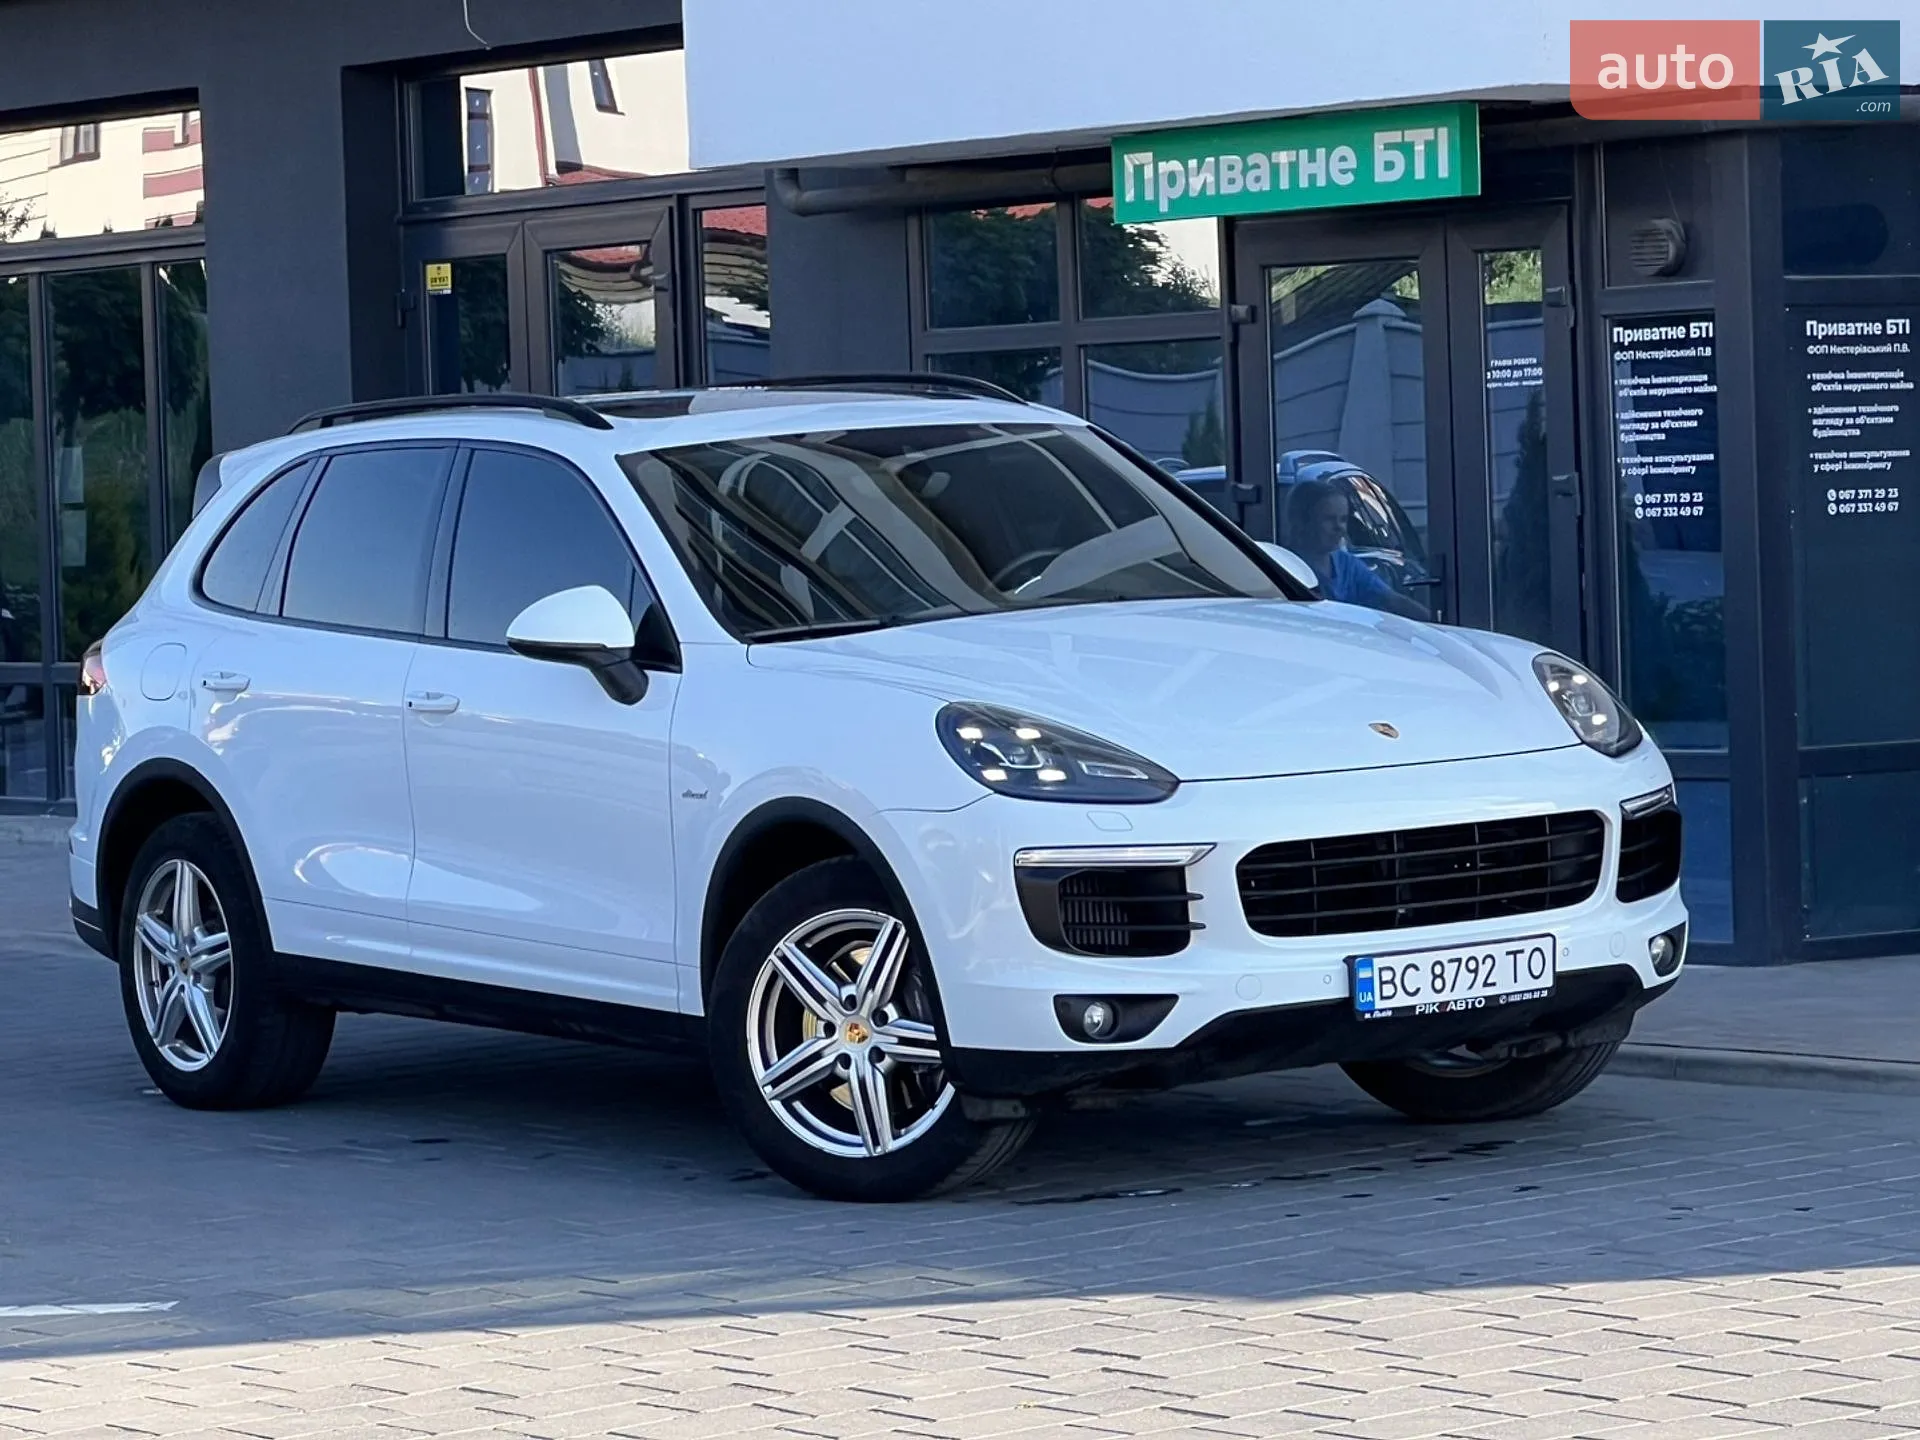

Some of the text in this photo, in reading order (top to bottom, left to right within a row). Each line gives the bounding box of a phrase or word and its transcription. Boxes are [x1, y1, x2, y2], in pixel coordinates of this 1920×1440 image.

[1124, 126, 1450, 213] Приватне БТІ
[1613, 321, 1714, 346] Приватне БТІ
[1806, 318, 1910, 340] Приватне БТІ
[1614, 350, 1634, 360] ФОП
[1807, 344, 1829, 354] ФОП
[1813, 464, 1819, 473] у
[1645, 492, 1704, 503] 067 371 29 23
[1838, 488, 1899, 500] 067 371 29 23
[1645, 505, 1704, 517] 067 332 49 67
[1839, 503, 1856, 513] 067
[1874, 501, 1886, 512] 49
[1887, 501, 1899, 512] 67
[1378, 946, 1546, 1001] BC 8792 TO
[1359, 991, 1373, 1003] UA
[1415, 996, 1486, 1015] РІК АВТО
